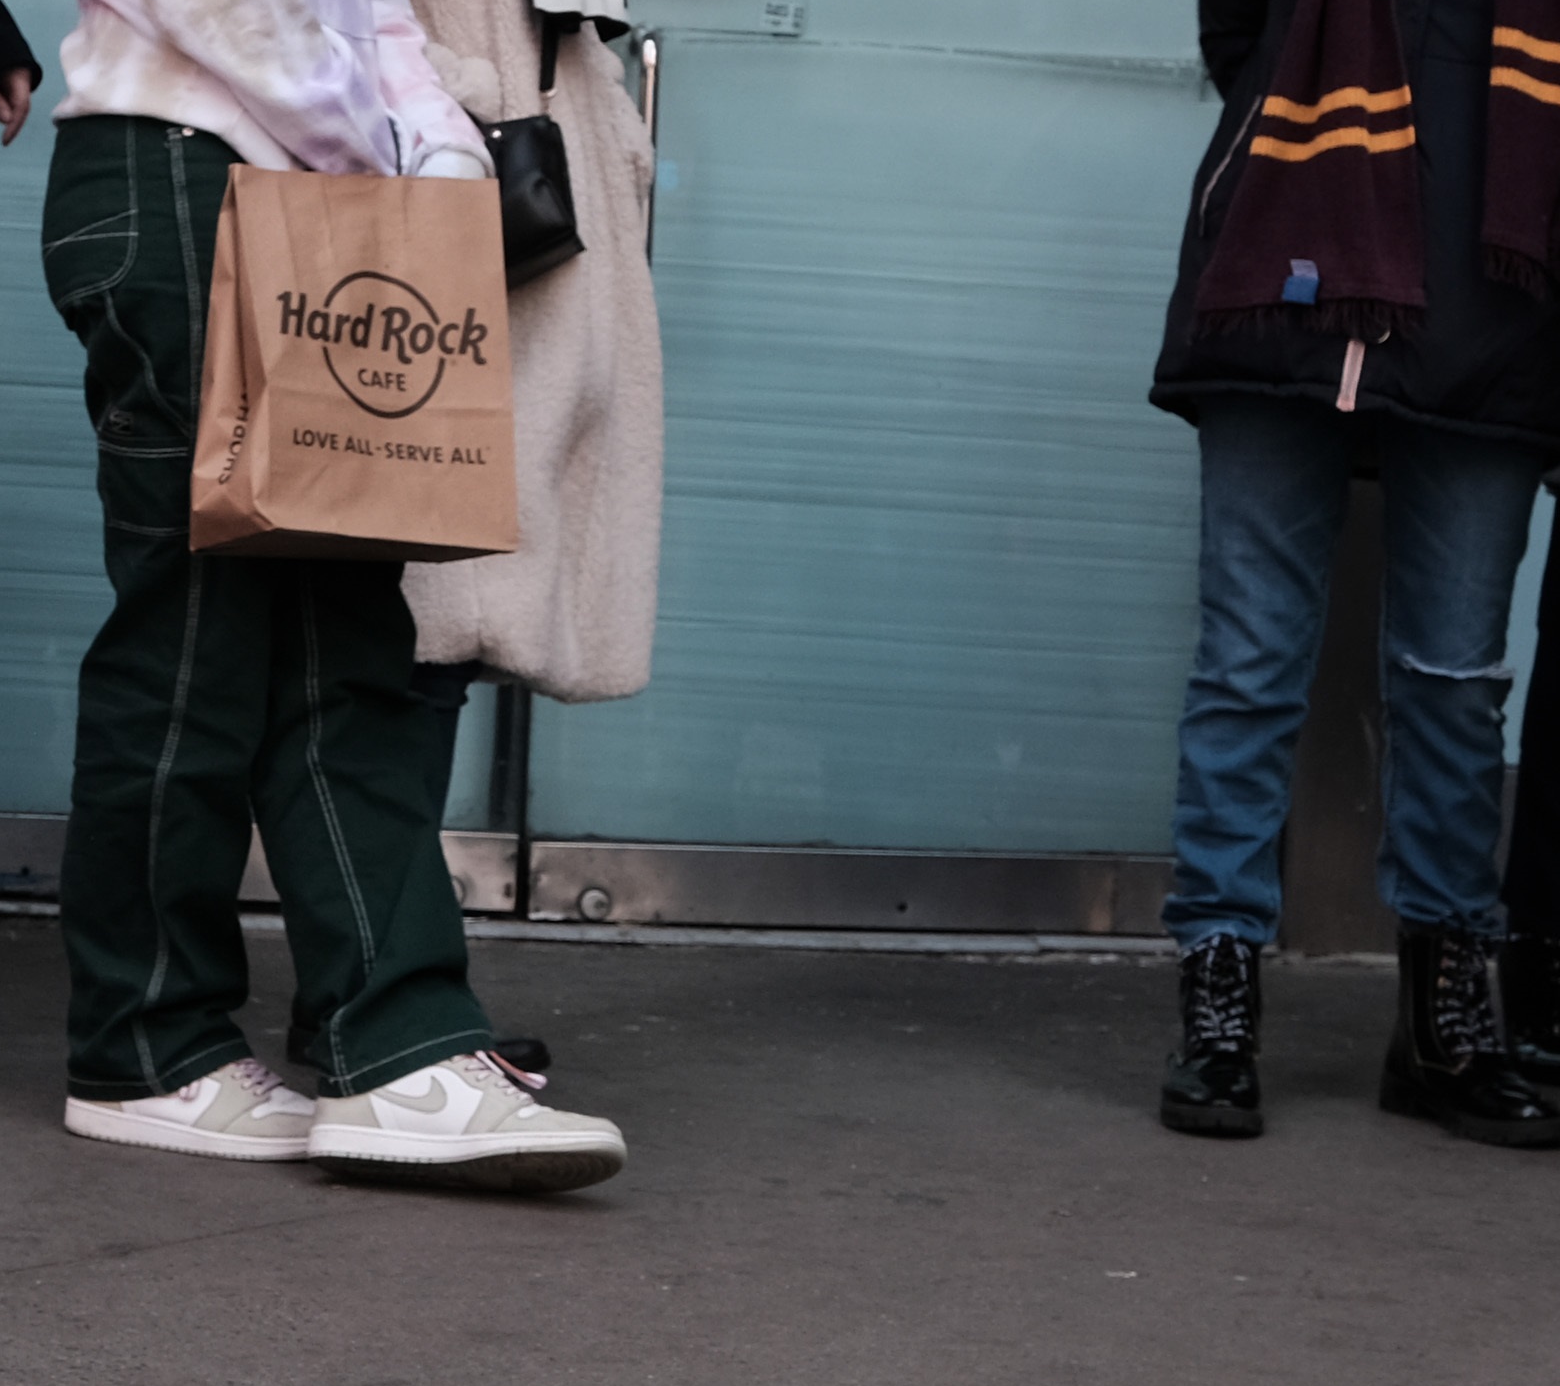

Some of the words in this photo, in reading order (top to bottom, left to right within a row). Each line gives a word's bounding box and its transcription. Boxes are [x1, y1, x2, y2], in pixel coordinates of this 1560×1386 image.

[276, 290, 376, 349] Hard
[380, 305, 489, 365] Rock
[357, 368, 408, 392] CAFE
[293, 428, 339, 452] LOVE
[450, 446, 487, 465] ALL
